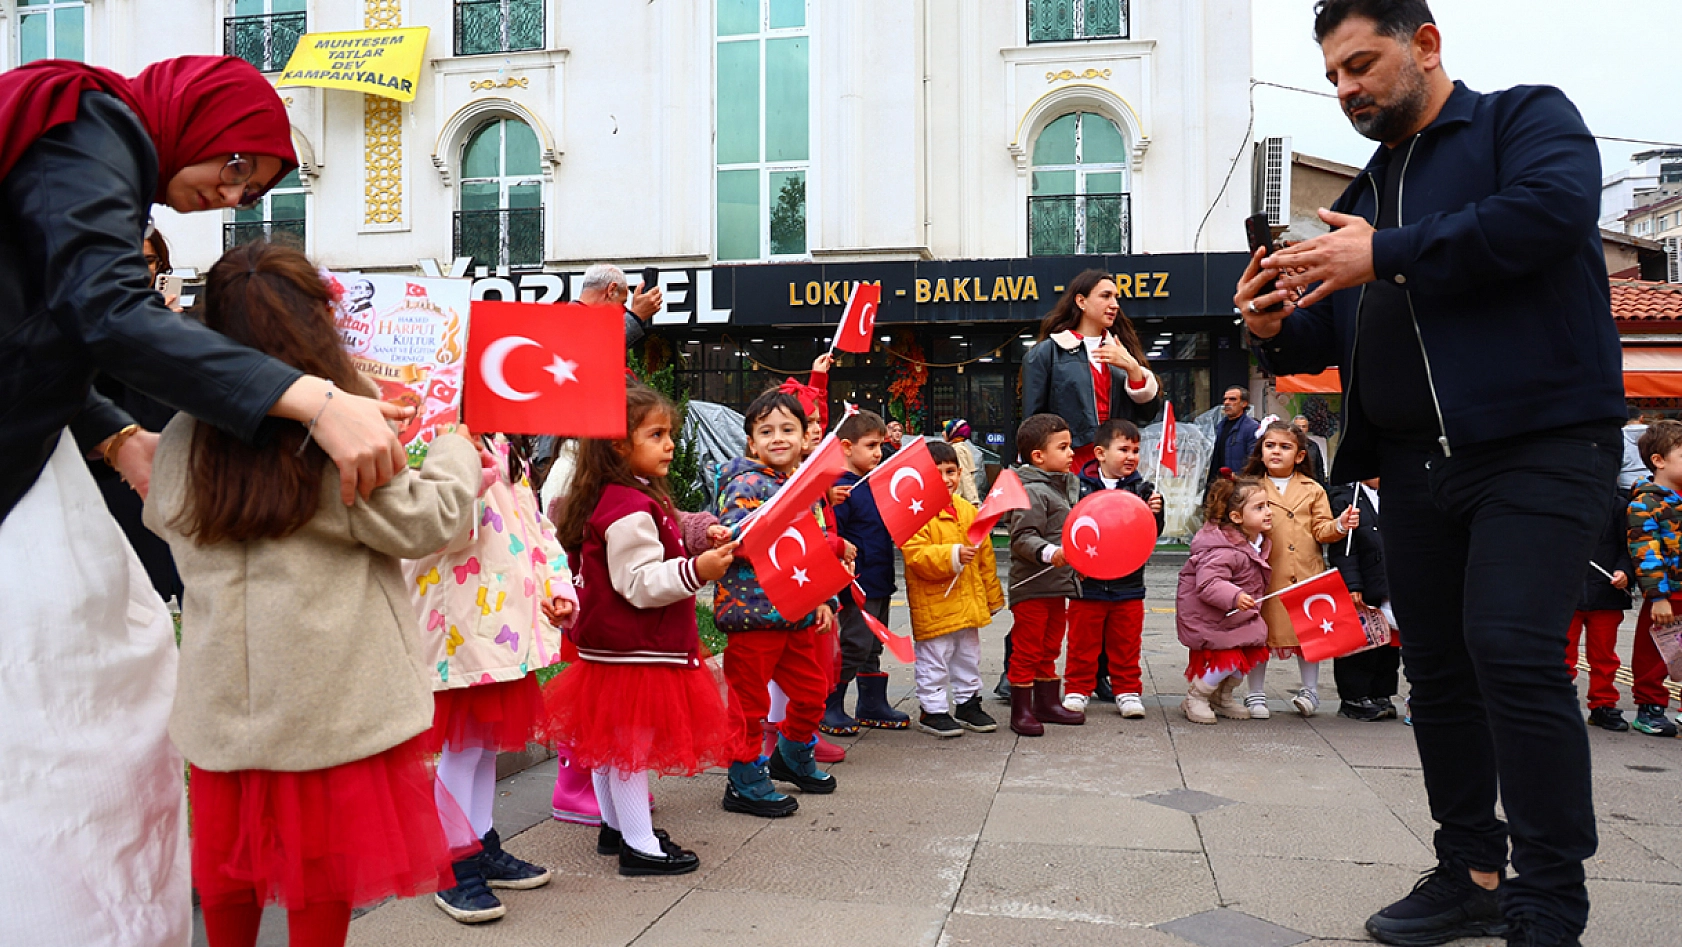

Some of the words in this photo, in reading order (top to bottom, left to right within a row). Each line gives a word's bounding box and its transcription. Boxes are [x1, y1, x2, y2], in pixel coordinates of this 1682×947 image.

[327, 48, 385, 60] TATLAR
[331, 60, 366, 70] DEV
[282, 70, 413, 94] KAMPANYALAR
[418, 257, 732, 324] ÖREL
[789, 279, 882, 306] LOKU
[915, 275, 1039, 303] BAKLAVA
[1110, 273, 1169, 299] REZ
[334, 313, 370, 334] ultan
[378, 320, 437, 335] HARPUT
